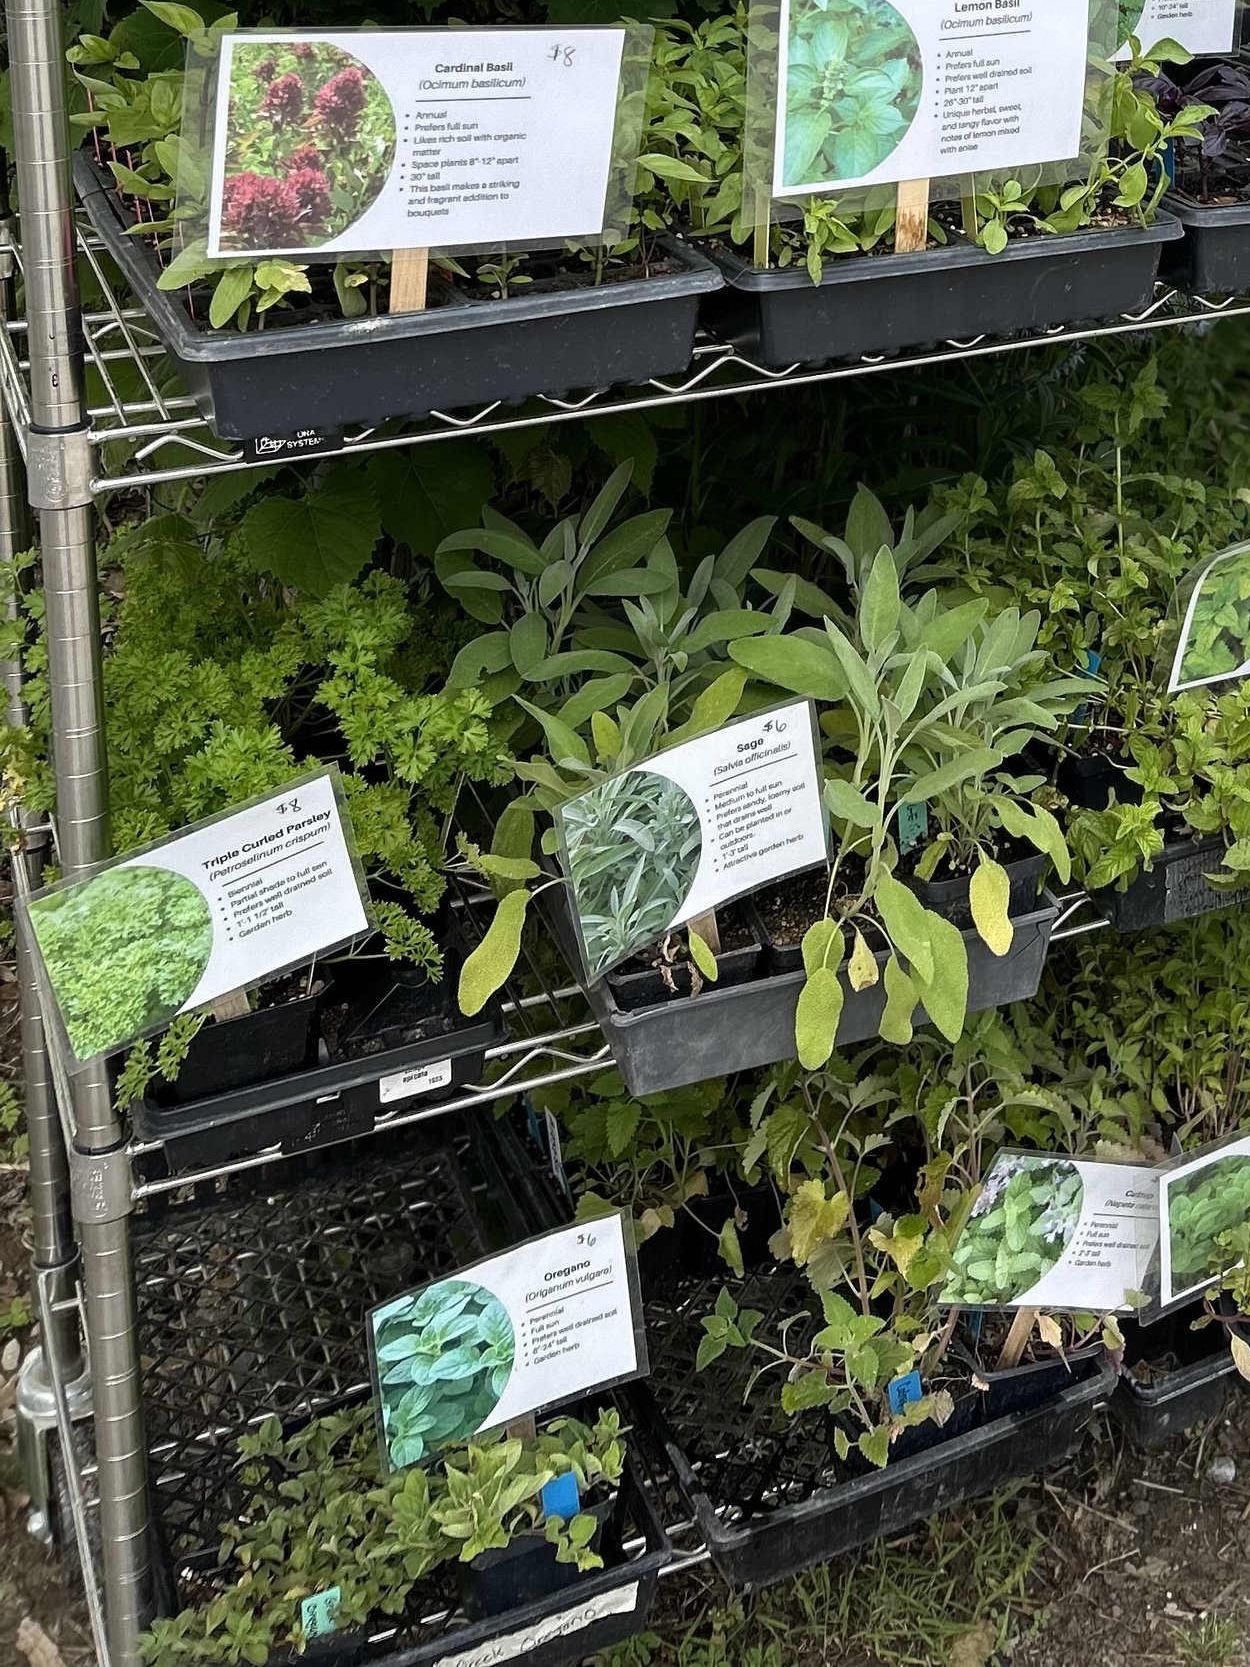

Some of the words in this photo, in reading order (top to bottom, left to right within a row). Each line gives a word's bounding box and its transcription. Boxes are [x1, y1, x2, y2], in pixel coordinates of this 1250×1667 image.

[954, 1, 992, 12] Lemon
[940, 18, 983, 30] (Ocimum
[985, 11, 1032, 25] basilicum)
[945, 48, 973, 58] Annual
[434, 62, 484, 73] Cardinal
[486, 61, 513, 72] Basil
[945, 61, 972, 70] Prefers
[972, 58, 985, 68] full
[418, 79, 469, 90] (Ocimum
[470, 76, 526, 88] basilicum)
[944, 86, 963, 95] Plant
[978, 82, 998, 91] apart
[415, 110, 447, 119] Annual
[414, 123, 445, 131] Prefers
[446, 122, 460, 130] full
[461, 122, 478, 130] sun
[413, 135, 437, 144] Likes
[438, 134, 455, 143] rich
[456, 133, 472, 142] soil
[473, 133, 492, 141] with
[493, 132, 527, 142] organic
[412, 148, 441, 156] matter
[426, 171, 440, 180] tall
[762, 719, 786, 732] $6
[736, 737, 764, 752] Sage
[713, 759, 743, 776] (Salvia
[744, 740, 790, 764] officinalis)
[714, 794, 745, 810] Medium
[745, 790, 754, 798] to
[754, 784, 767, 794] full
[768, 780, 782, 790] sun
[275, 797, 301, 814] $8
[201, 849, 239, 869] Triple
[241, 828, 284, 852] Curled
[286, 809, 331, 834] Parsley
[209, 844, 283, 881] (Petroselinum
[284, 821, 330, 848] crispum)
[233, 900, 263, 918] Prefers
[263, 890, 282, 903] well
[283, 874, 316, 894] drained
[317, 868, 332, 880] soil
[238, 919, 271, 937] Garden
[271, 909, 292, 922] herb
[544, 1260, 590, 1281] Oregano
[525, 1279, 573, 1303] (Origanum
[574, 1264, 612, 1284] vulgare)
